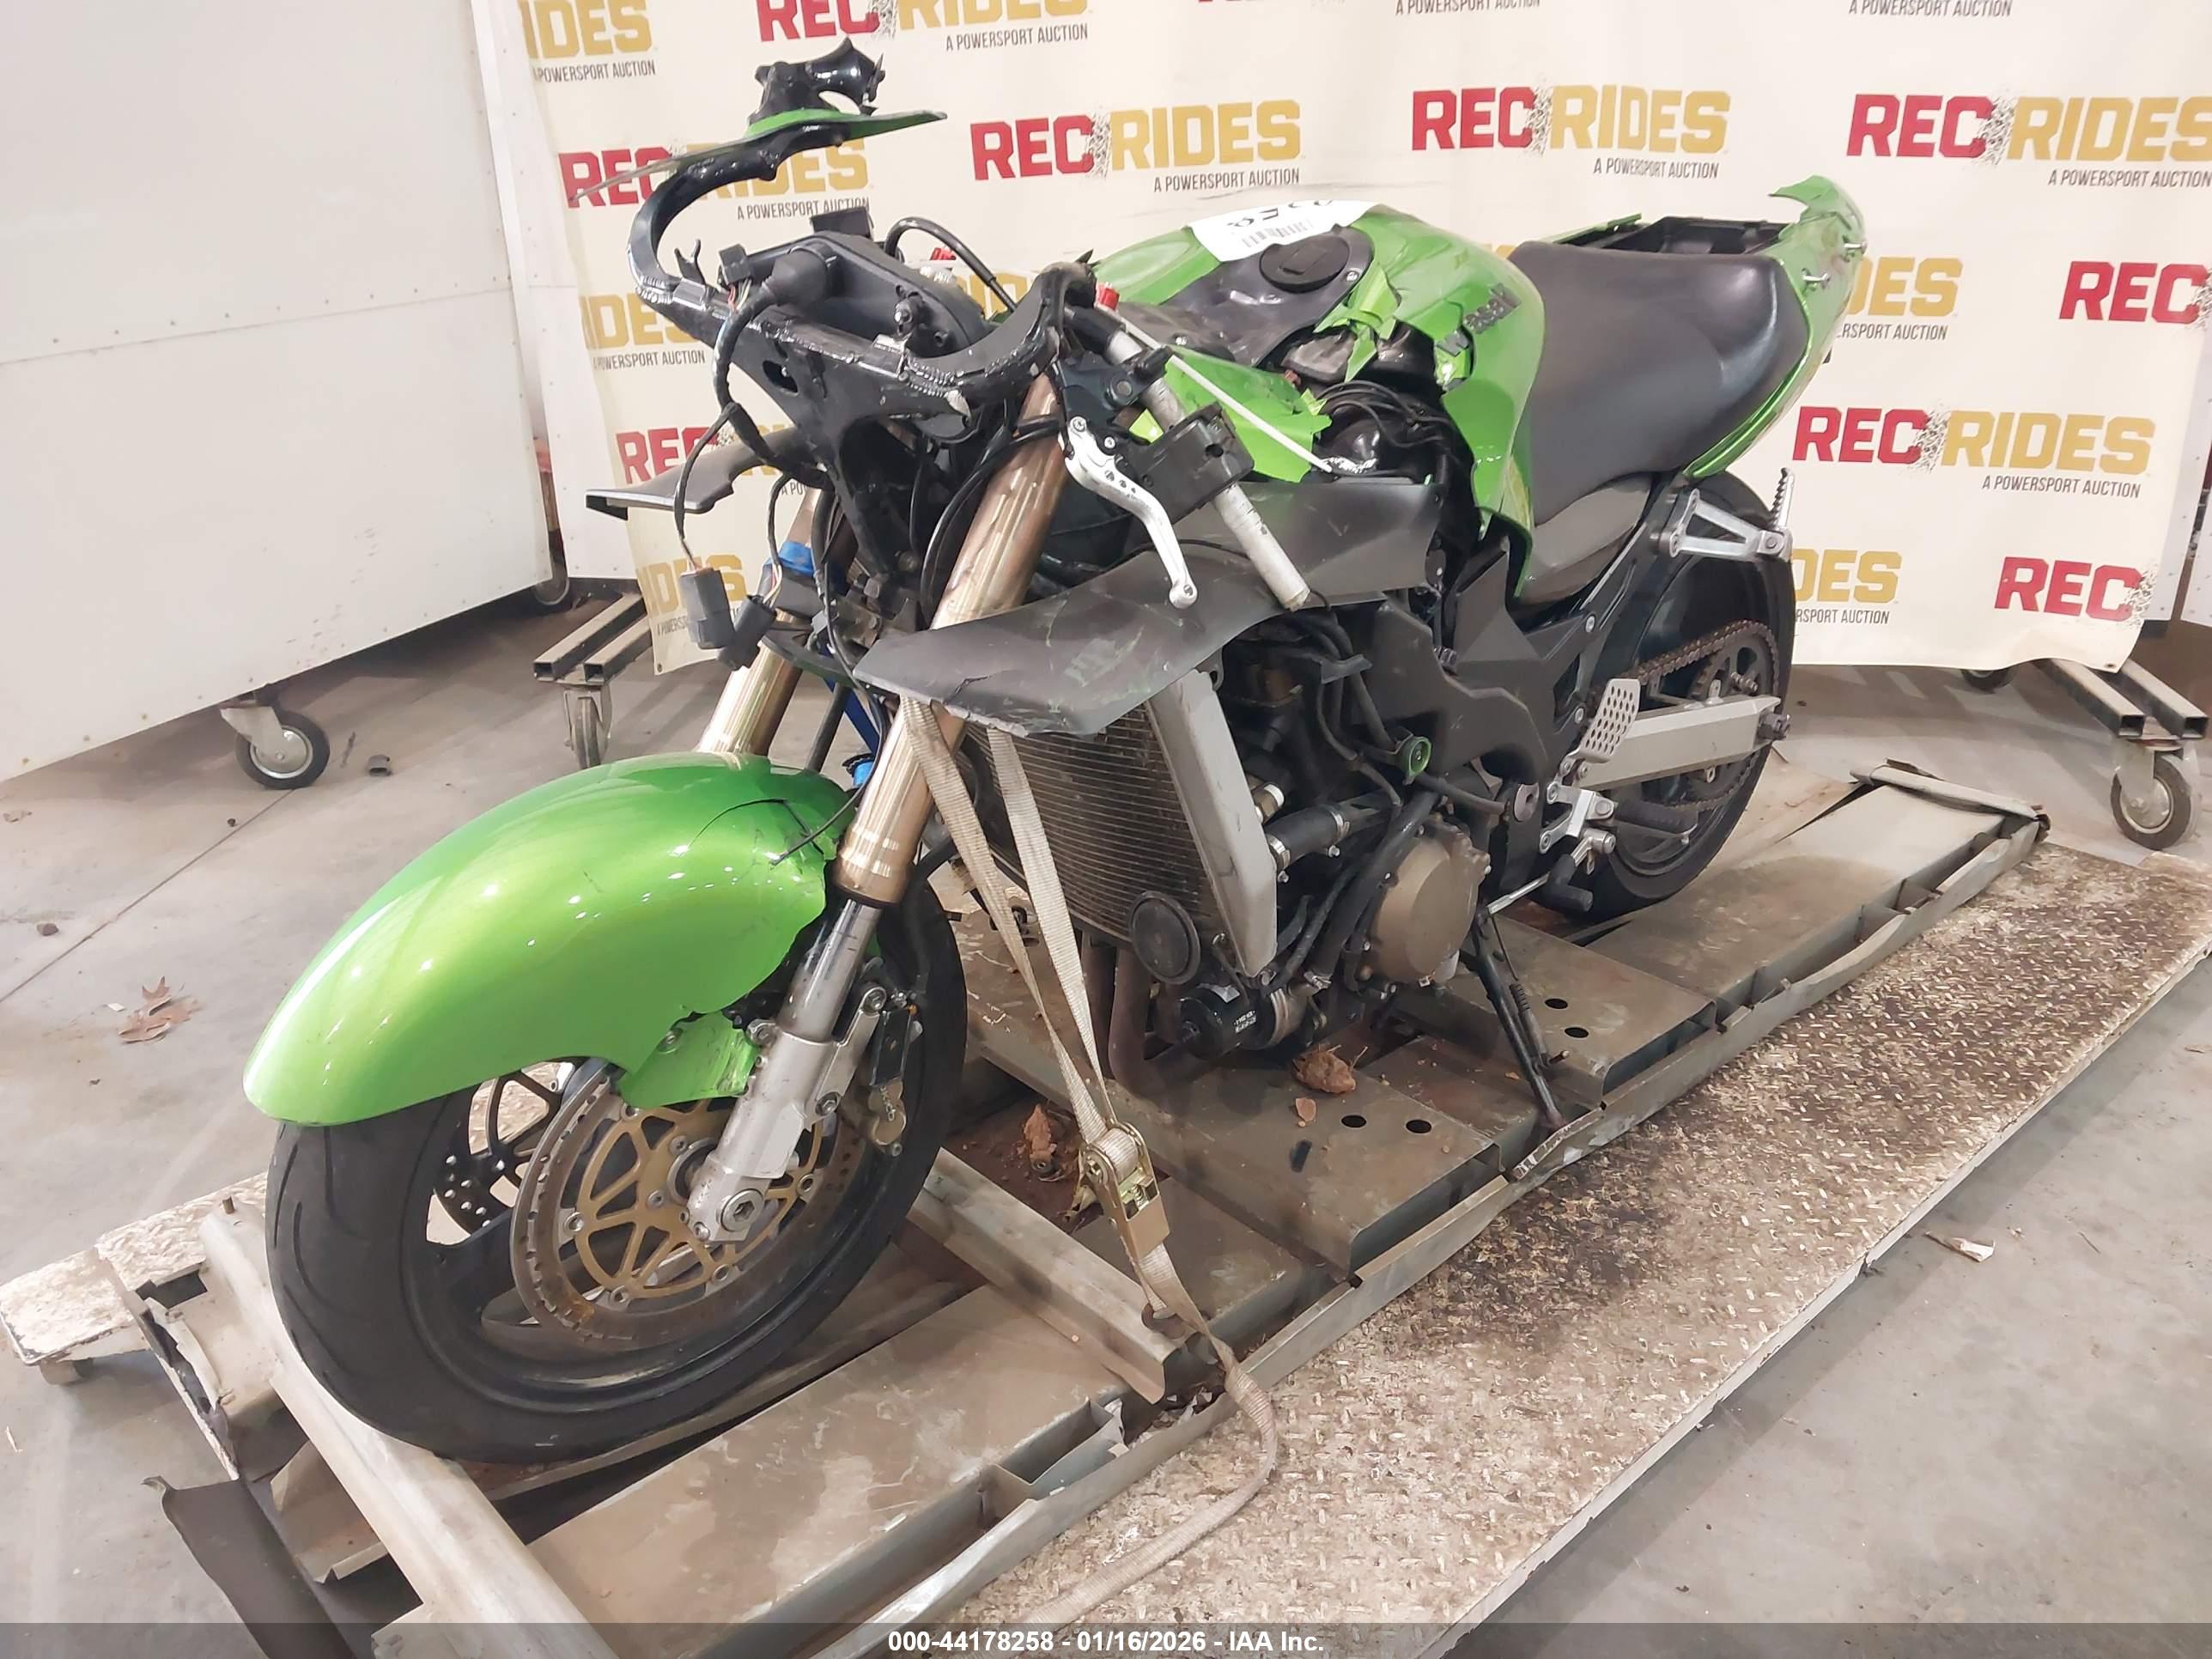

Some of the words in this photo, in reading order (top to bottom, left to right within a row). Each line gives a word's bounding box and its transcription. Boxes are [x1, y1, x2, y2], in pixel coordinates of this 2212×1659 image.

[1848, 0, 1858, 15] A
[1861, 0, 1951, 16] POWERSPORT
[1952, 0, 2012, 17] AUCTION
[945, 34, 954, 52] A
[957, 27, 1033, 51] POWERSPORT
[1037, 22, 1088, 44] AUCTION
[612, 60, 656, 79] AUCTION
[1412, 87, 1537, 150] REC
[1550, 85, 1731, 154] RIDES
[1846, 94, 1996, 158] REC
[2007, 96, 2212, 162] RIDES
[970, 114, 1095, 181] REC
[1109, 99, 1301, 171] RIDES
[1154, 176, 1162, 192] A
[1165, 171, 1245, 192] POWERSPORT
[1249, 167, 1299, 186] AUCTION
[1593, 157, 1602, 174] A
[1668, 161, 1720, 179] AUCTION
[2048, 169, 2058, 186] A
[2060, 169, 2149, 188] POWERSPORT
[2149, 170, 2212, 188] AUCTION
[737, 205, 744, 220] A
[747, 200, 820, 219] POWERSPORT
[2059, 260, 2210, 324] REC
[1841, 322, 1892, 339] RSPORT
[1893, 324, 1948, 341] AUCTION
[662, 349, 705, 365] AUCTION
[1792, 406, 1930, 465] REC
[1941, 410, 2156, 476] RIDES
[616, 427, 720, 484] RE
[1982, 475, 1990, 490] A
[1993, 475, 2081, 494] POWERSPORT
[2082, 479, 2142, 499] AUCTION
[1791, 548, 1902, 604] DES
[1995, 556, 2142, 622] REC
[1795, 608, 1838, 623] RSPORT
[1840, 609, 1890, 624] AUCTION
